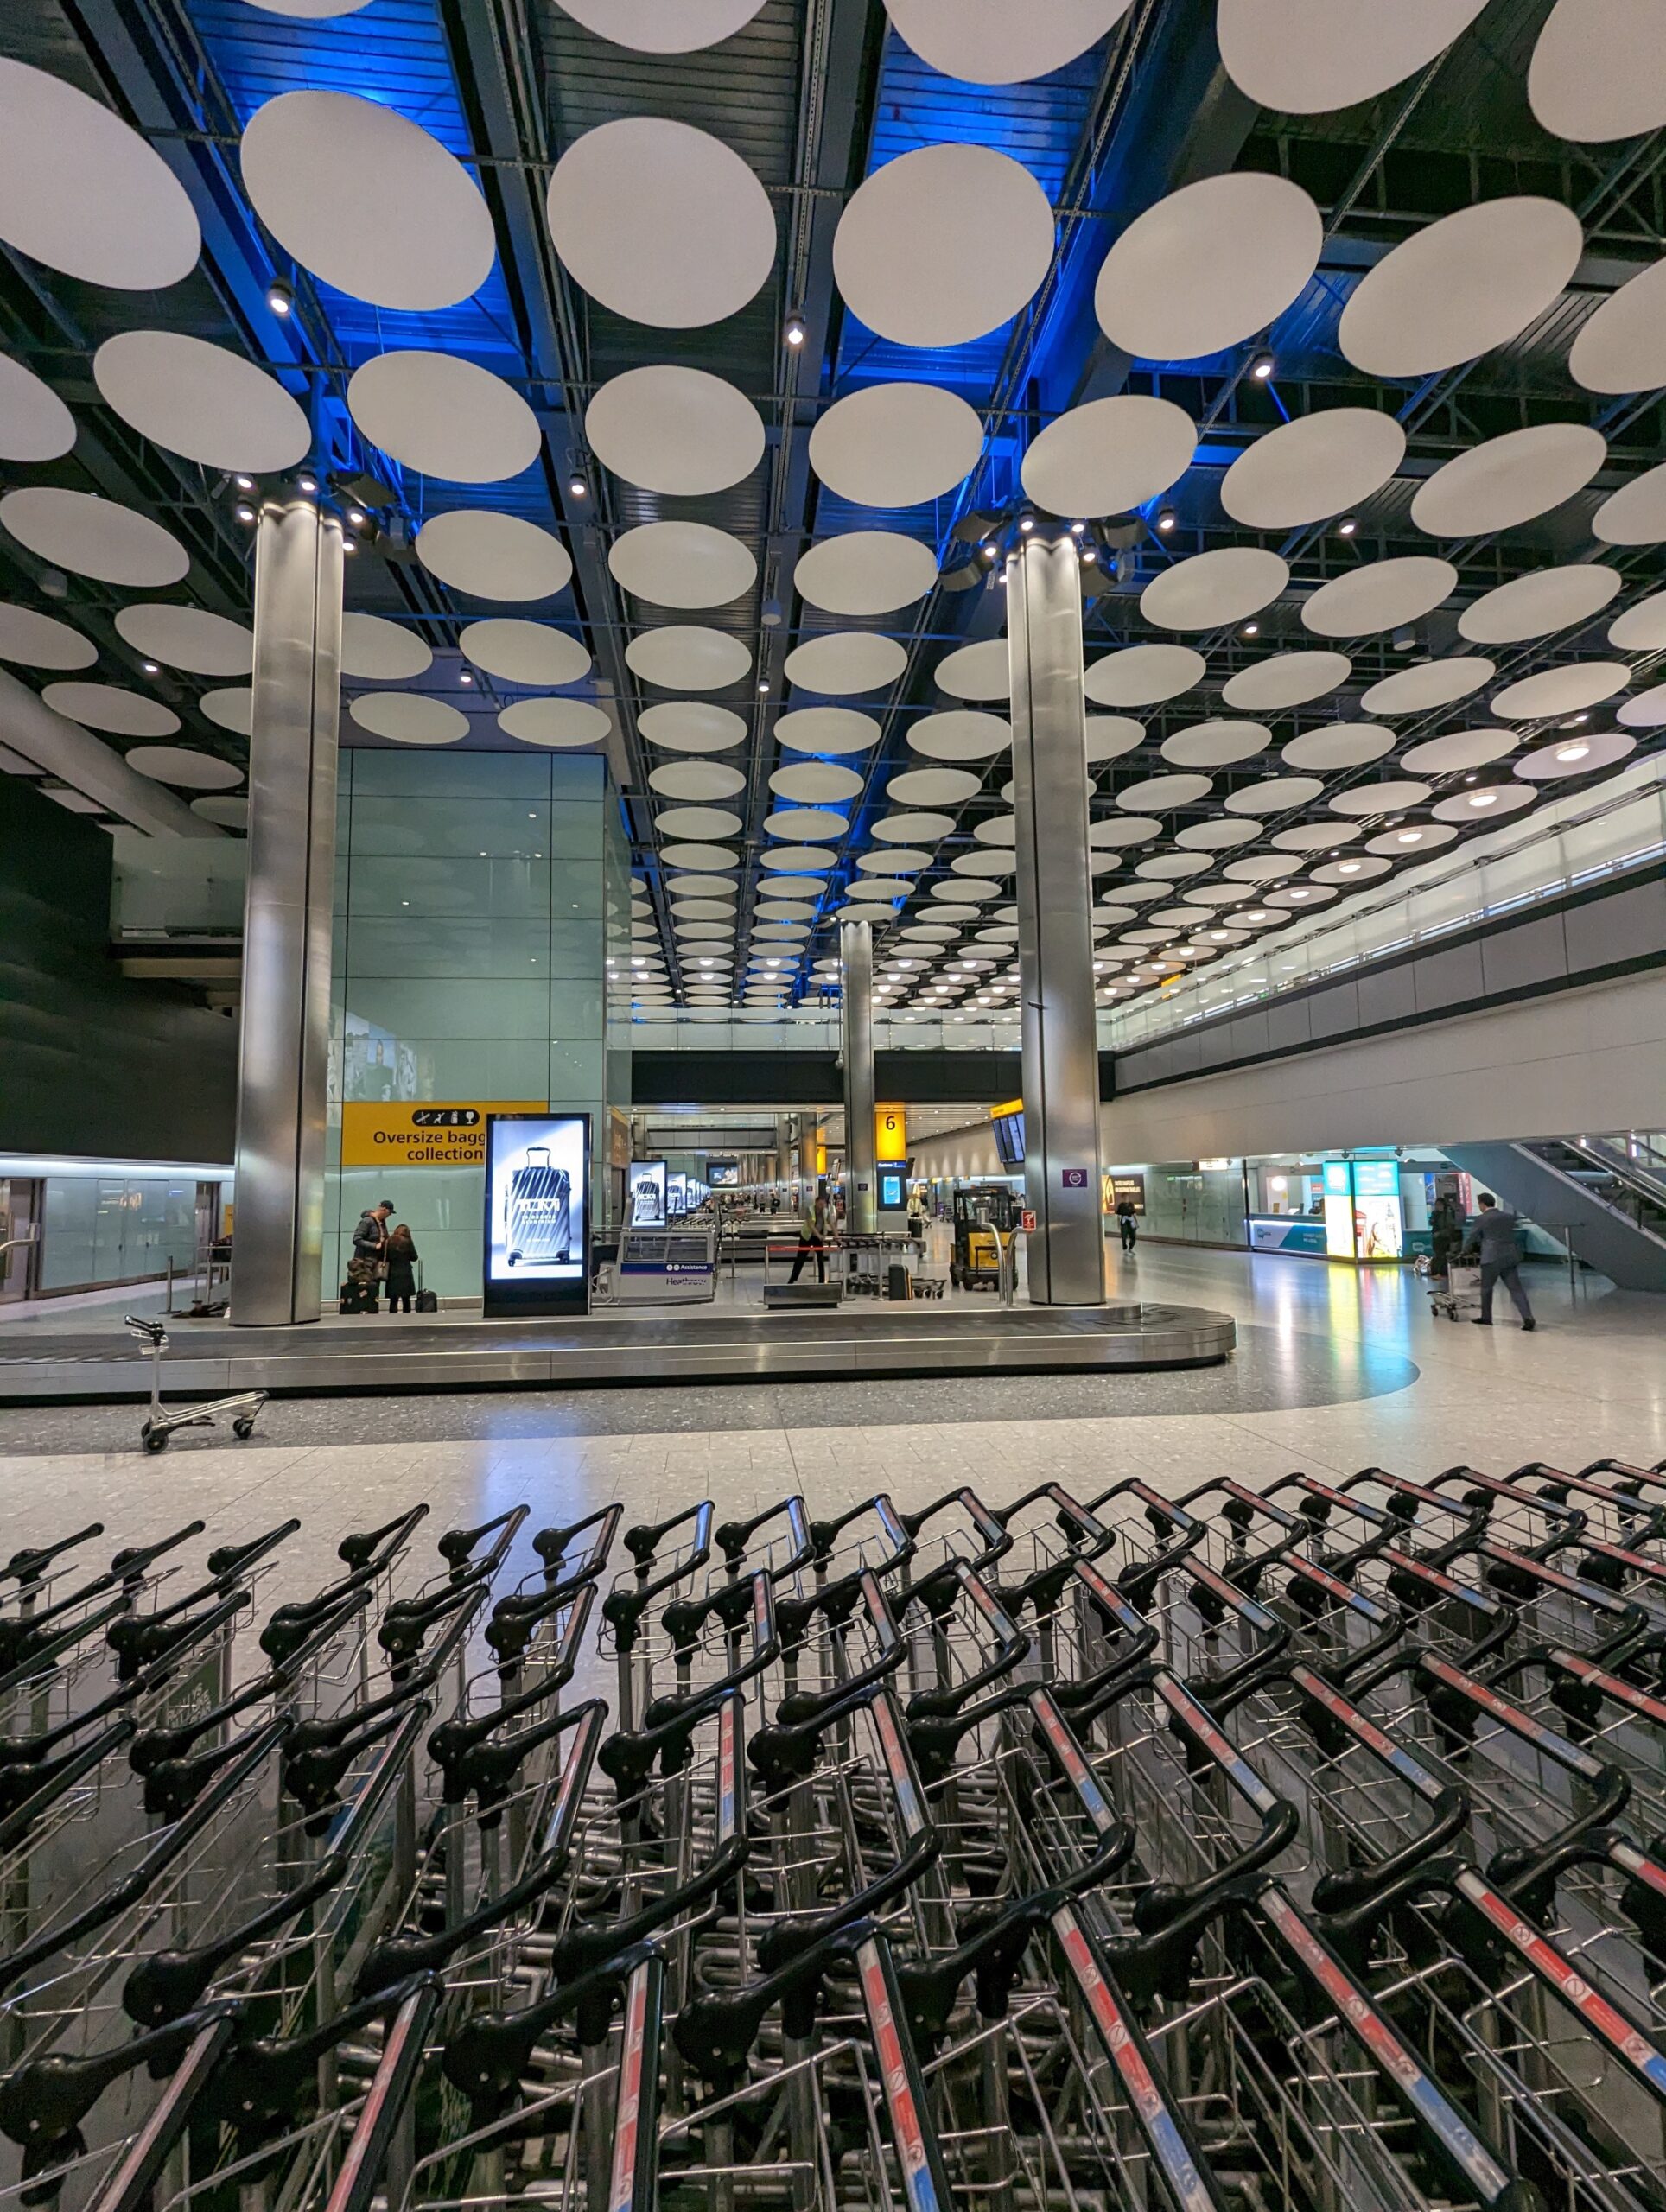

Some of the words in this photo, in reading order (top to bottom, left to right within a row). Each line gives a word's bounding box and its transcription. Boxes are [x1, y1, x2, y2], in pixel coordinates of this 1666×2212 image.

[886, 1116, 896, 1130] 6
[373, 1130, 443, 1144] Oversize
[407, 1147, 483, 1160] collection
